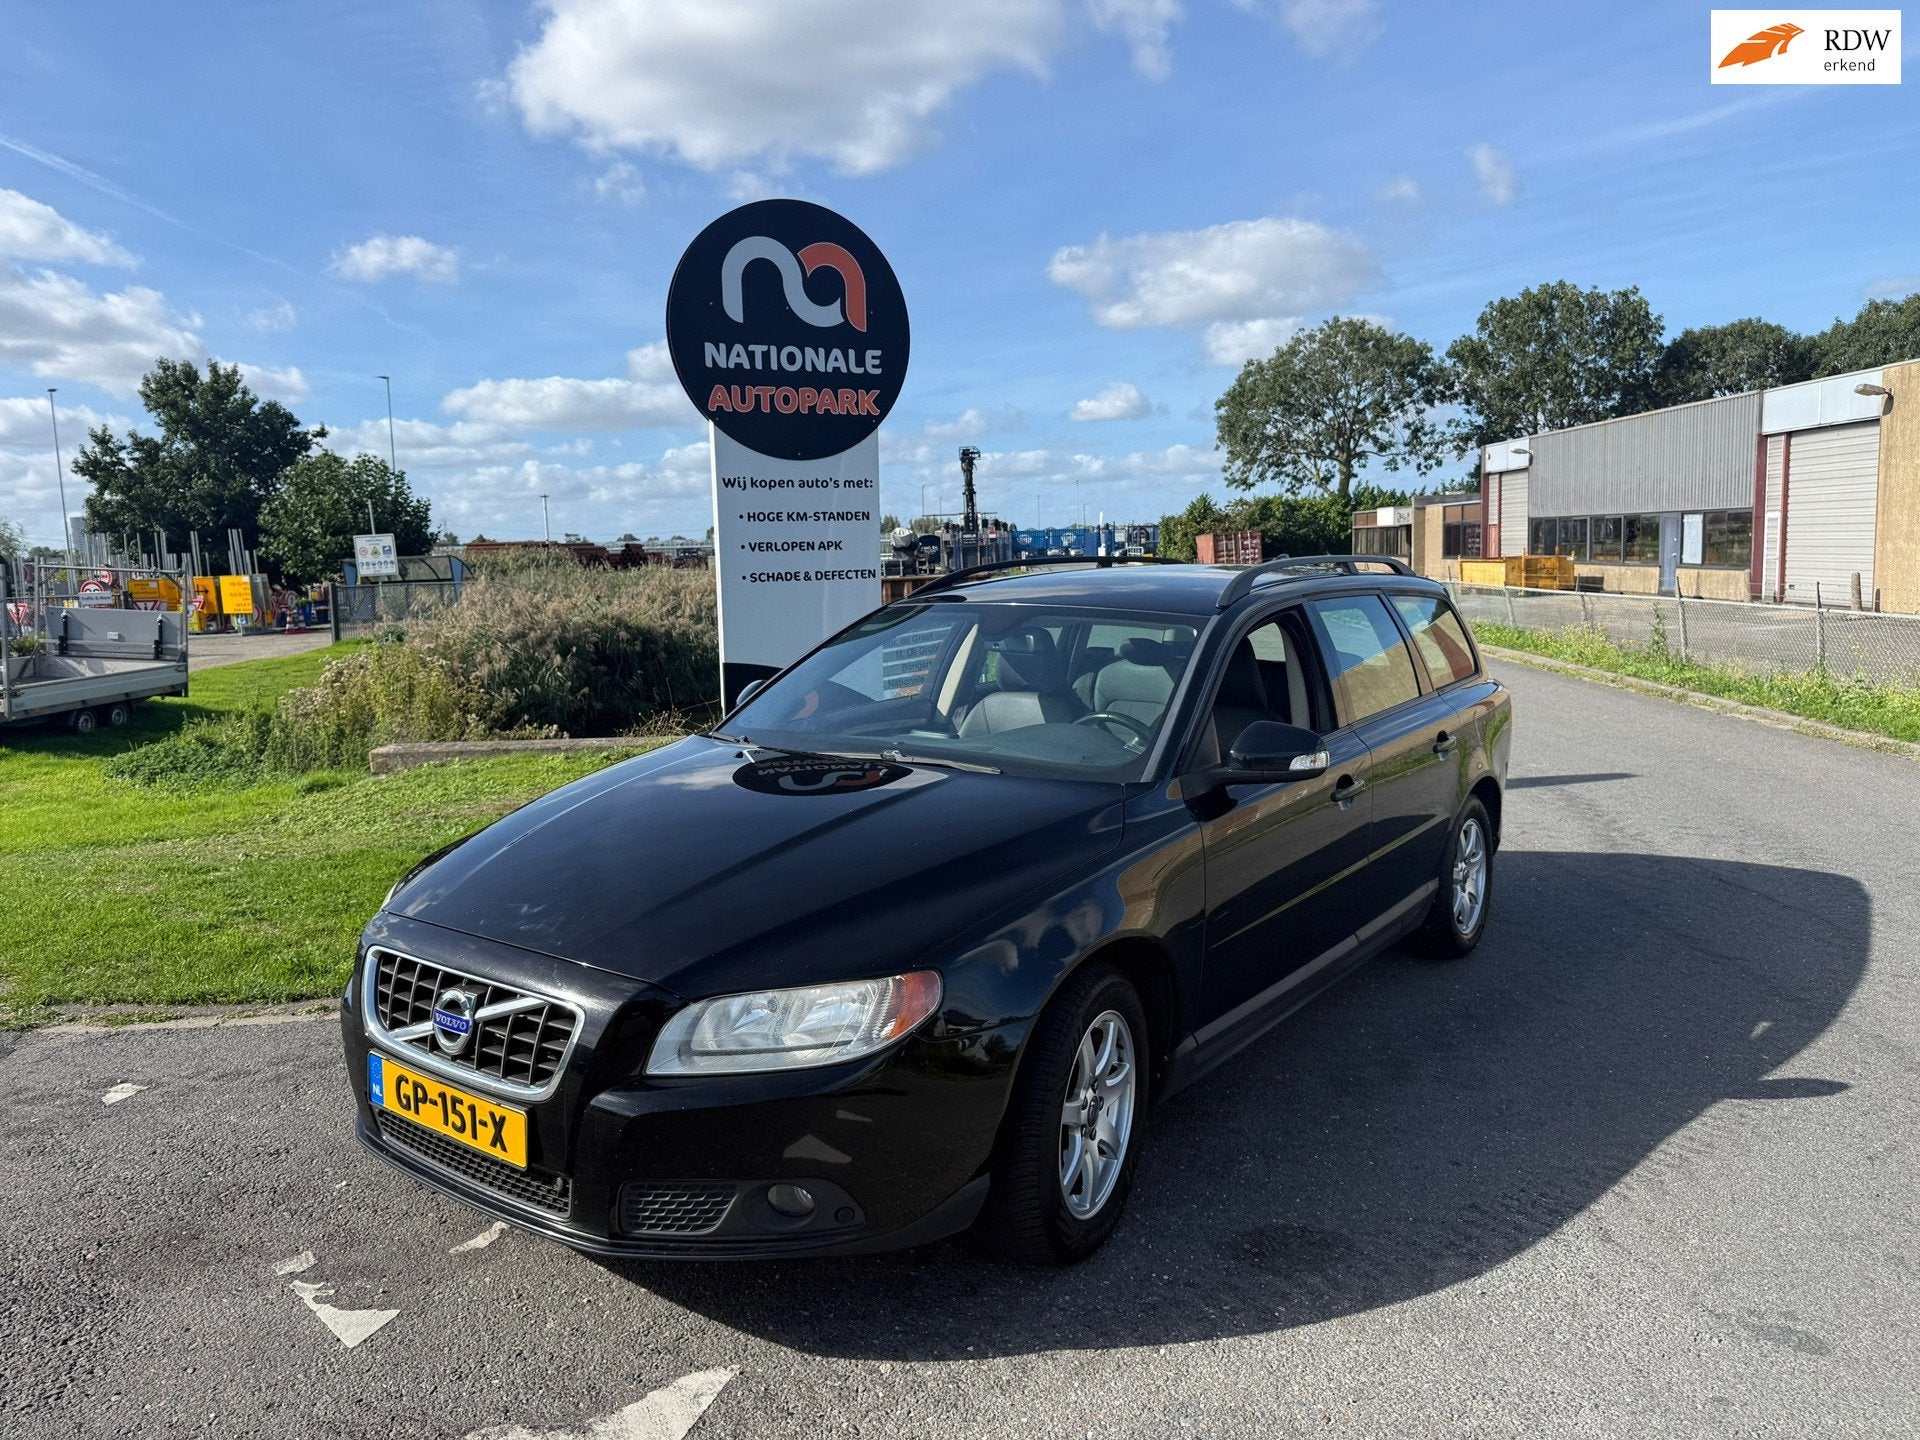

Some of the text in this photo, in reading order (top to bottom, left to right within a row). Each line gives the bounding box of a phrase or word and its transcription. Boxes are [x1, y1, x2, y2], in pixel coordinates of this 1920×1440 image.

[704, 342, 882, 375] NATIONALE
[707, 384, 881, 416] AUTOPARK
[722, 476, 874, 491] Wij kopen auto's met:
[747, 511, 870, 522] HOGE KM-STANDEN
[748, 540, 843, 552] VERLOPEN APK
[750, 569, 876, 583] SCHADE & DEFECTEN
[435, 1012, 468, 1031] VOLVO
[372, 1073, 508, 1154] NL GP-151-X
